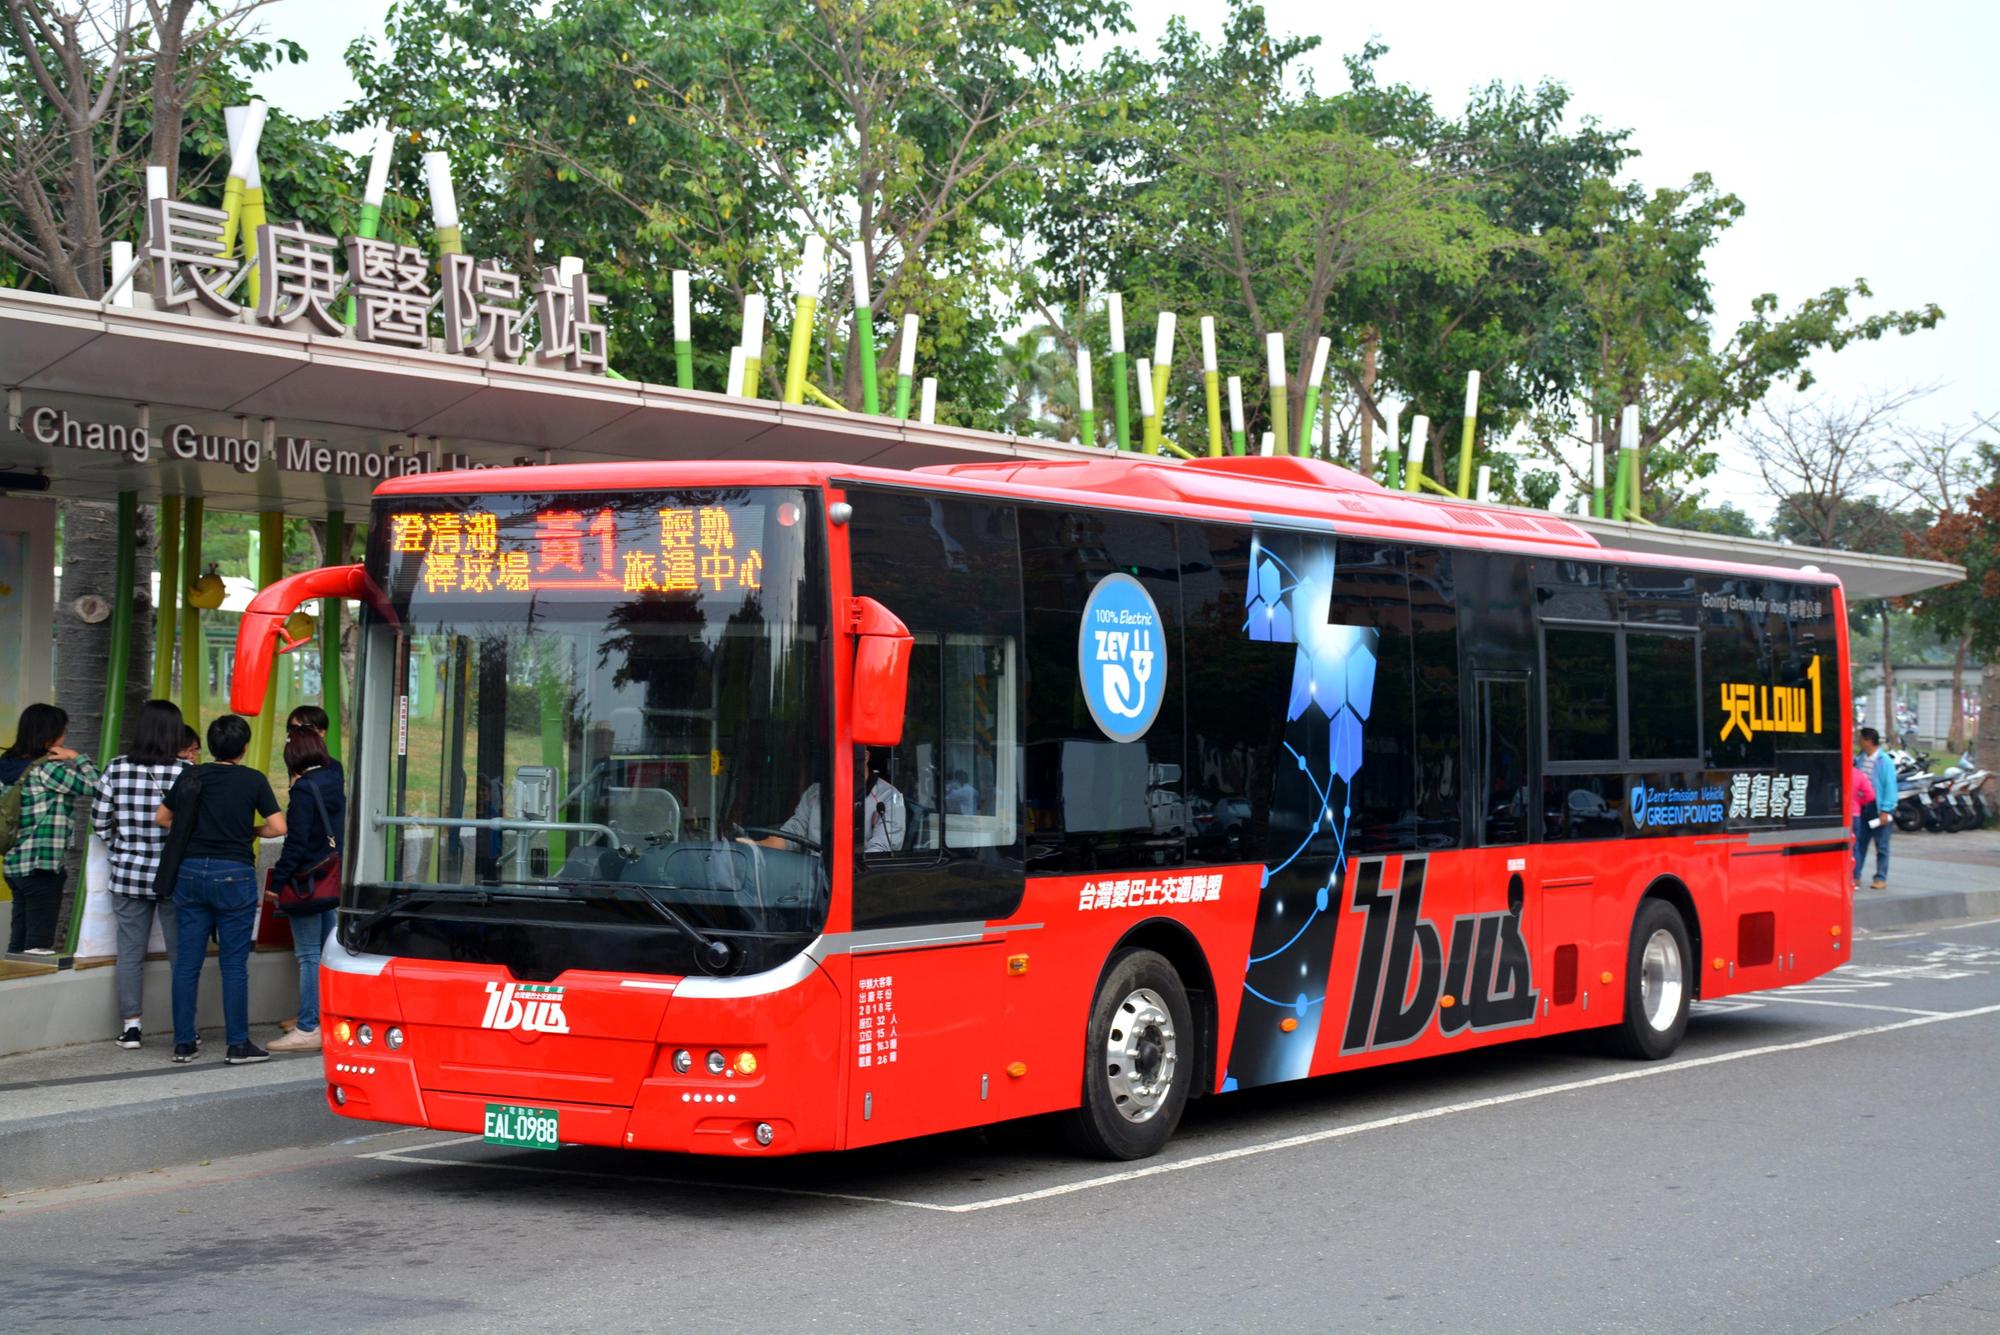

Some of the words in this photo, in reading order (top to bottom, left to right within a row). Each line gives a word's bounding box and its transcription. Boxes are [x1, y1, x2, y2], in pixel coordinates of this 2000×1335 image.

[141, 198, 609, 373] 長庚醫院站
[31, 406, 150, 462] Chang
[170, 424, 262, 473] Gung
[285, 437, 433, 478] Memorial
[392, 511, 498, 554] 澄清湖
[424, 551, 532, 593] 棒球場
[622, 549, 763, 592] 旅運中心
[1095, 609, 1119, 624] 100%
[1119, 609, 1153, 626] Electric
[1702, 591, 1728, 613] Going
[1728, 594, 1755, 611] Green
[1095, 630, 1130, 662] ZEV
[1728, 773, 1810, 819] 漢程客運
[1078, 874, 1224, 911] 台灣愛巴士交通聯盟
[890, 1013, 898, 1025] 人
[890, 1026, 898, 1037] 人
[484, 1111, 558, 1144] EAL-0988
